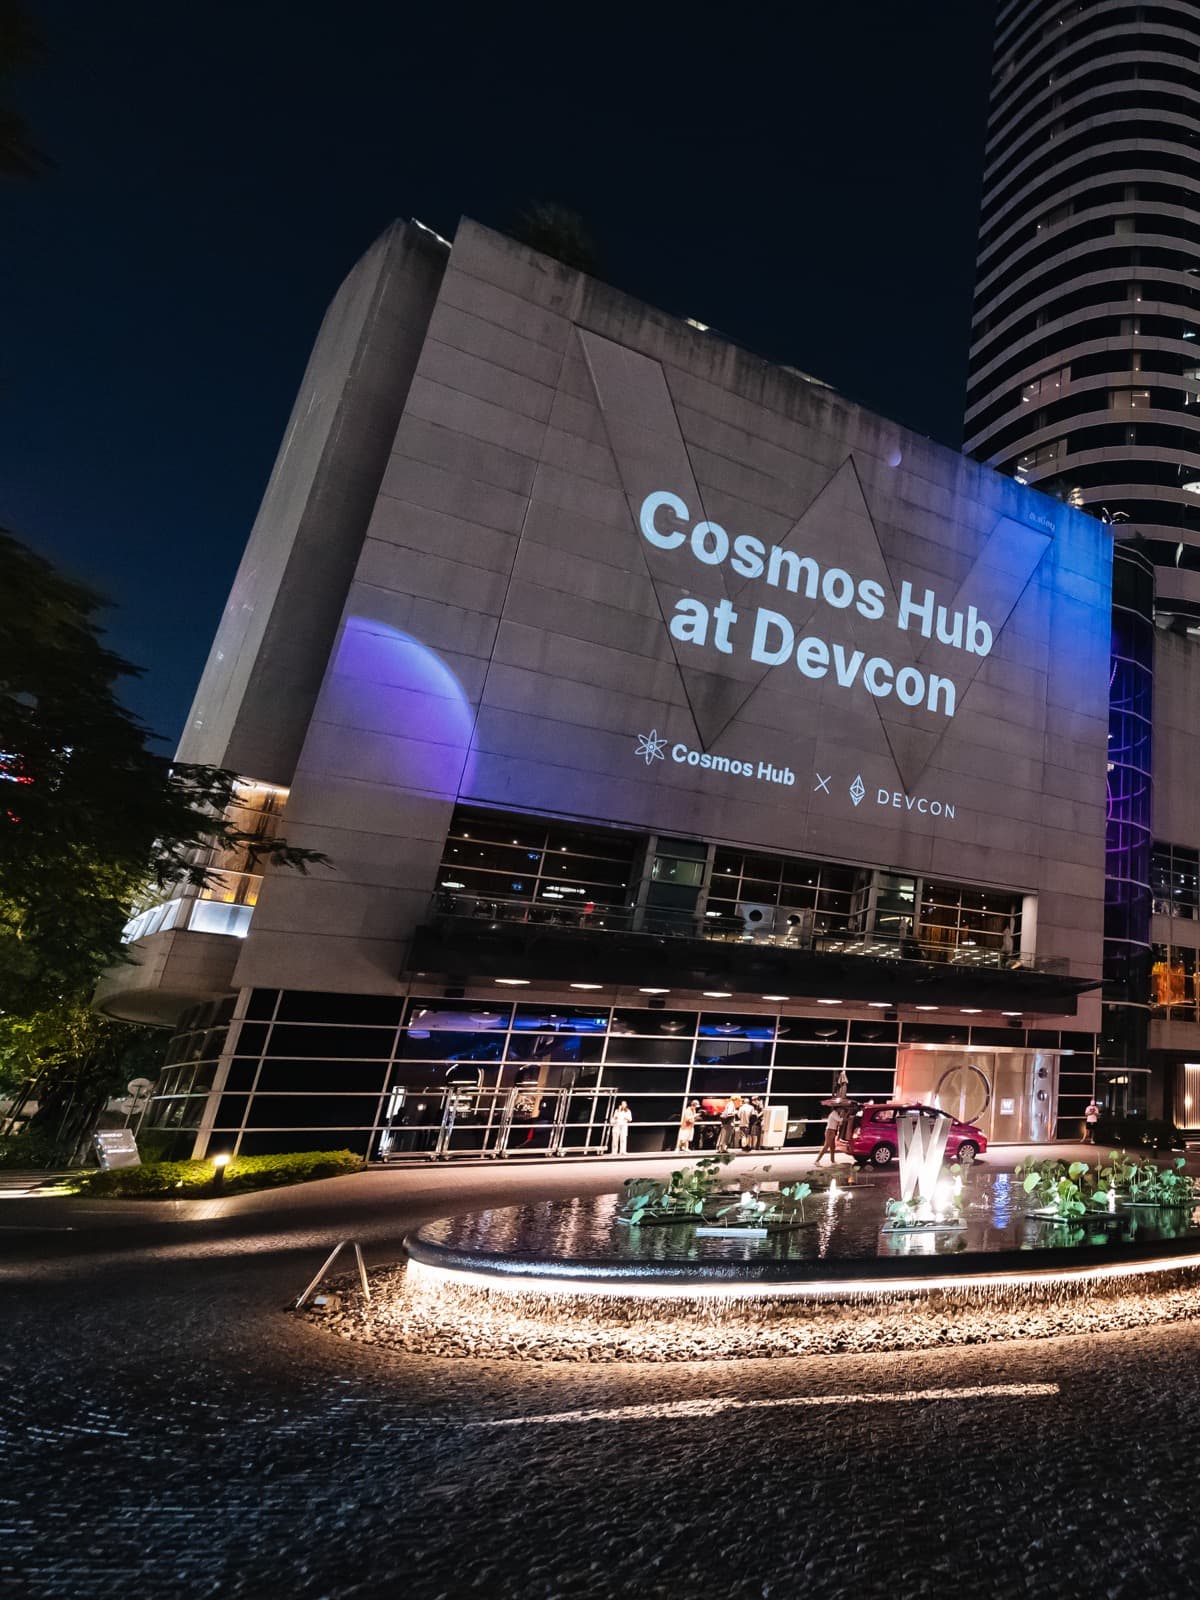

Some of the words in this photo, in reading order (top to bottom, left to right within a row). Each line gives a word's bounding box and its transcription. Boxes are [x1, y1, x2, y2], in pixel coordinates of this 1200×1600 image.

[639, 490, 886, 620] Cosmos
[897, 580, 993, 657] Hub
[669, 596, 738, 654] at
[750, 607, 956, 717] Devcon
[671, 743, 754, 777] Cosmos
[756, 761, 795, 786] Hub
[876, 788, 956, 820] DEVCON
